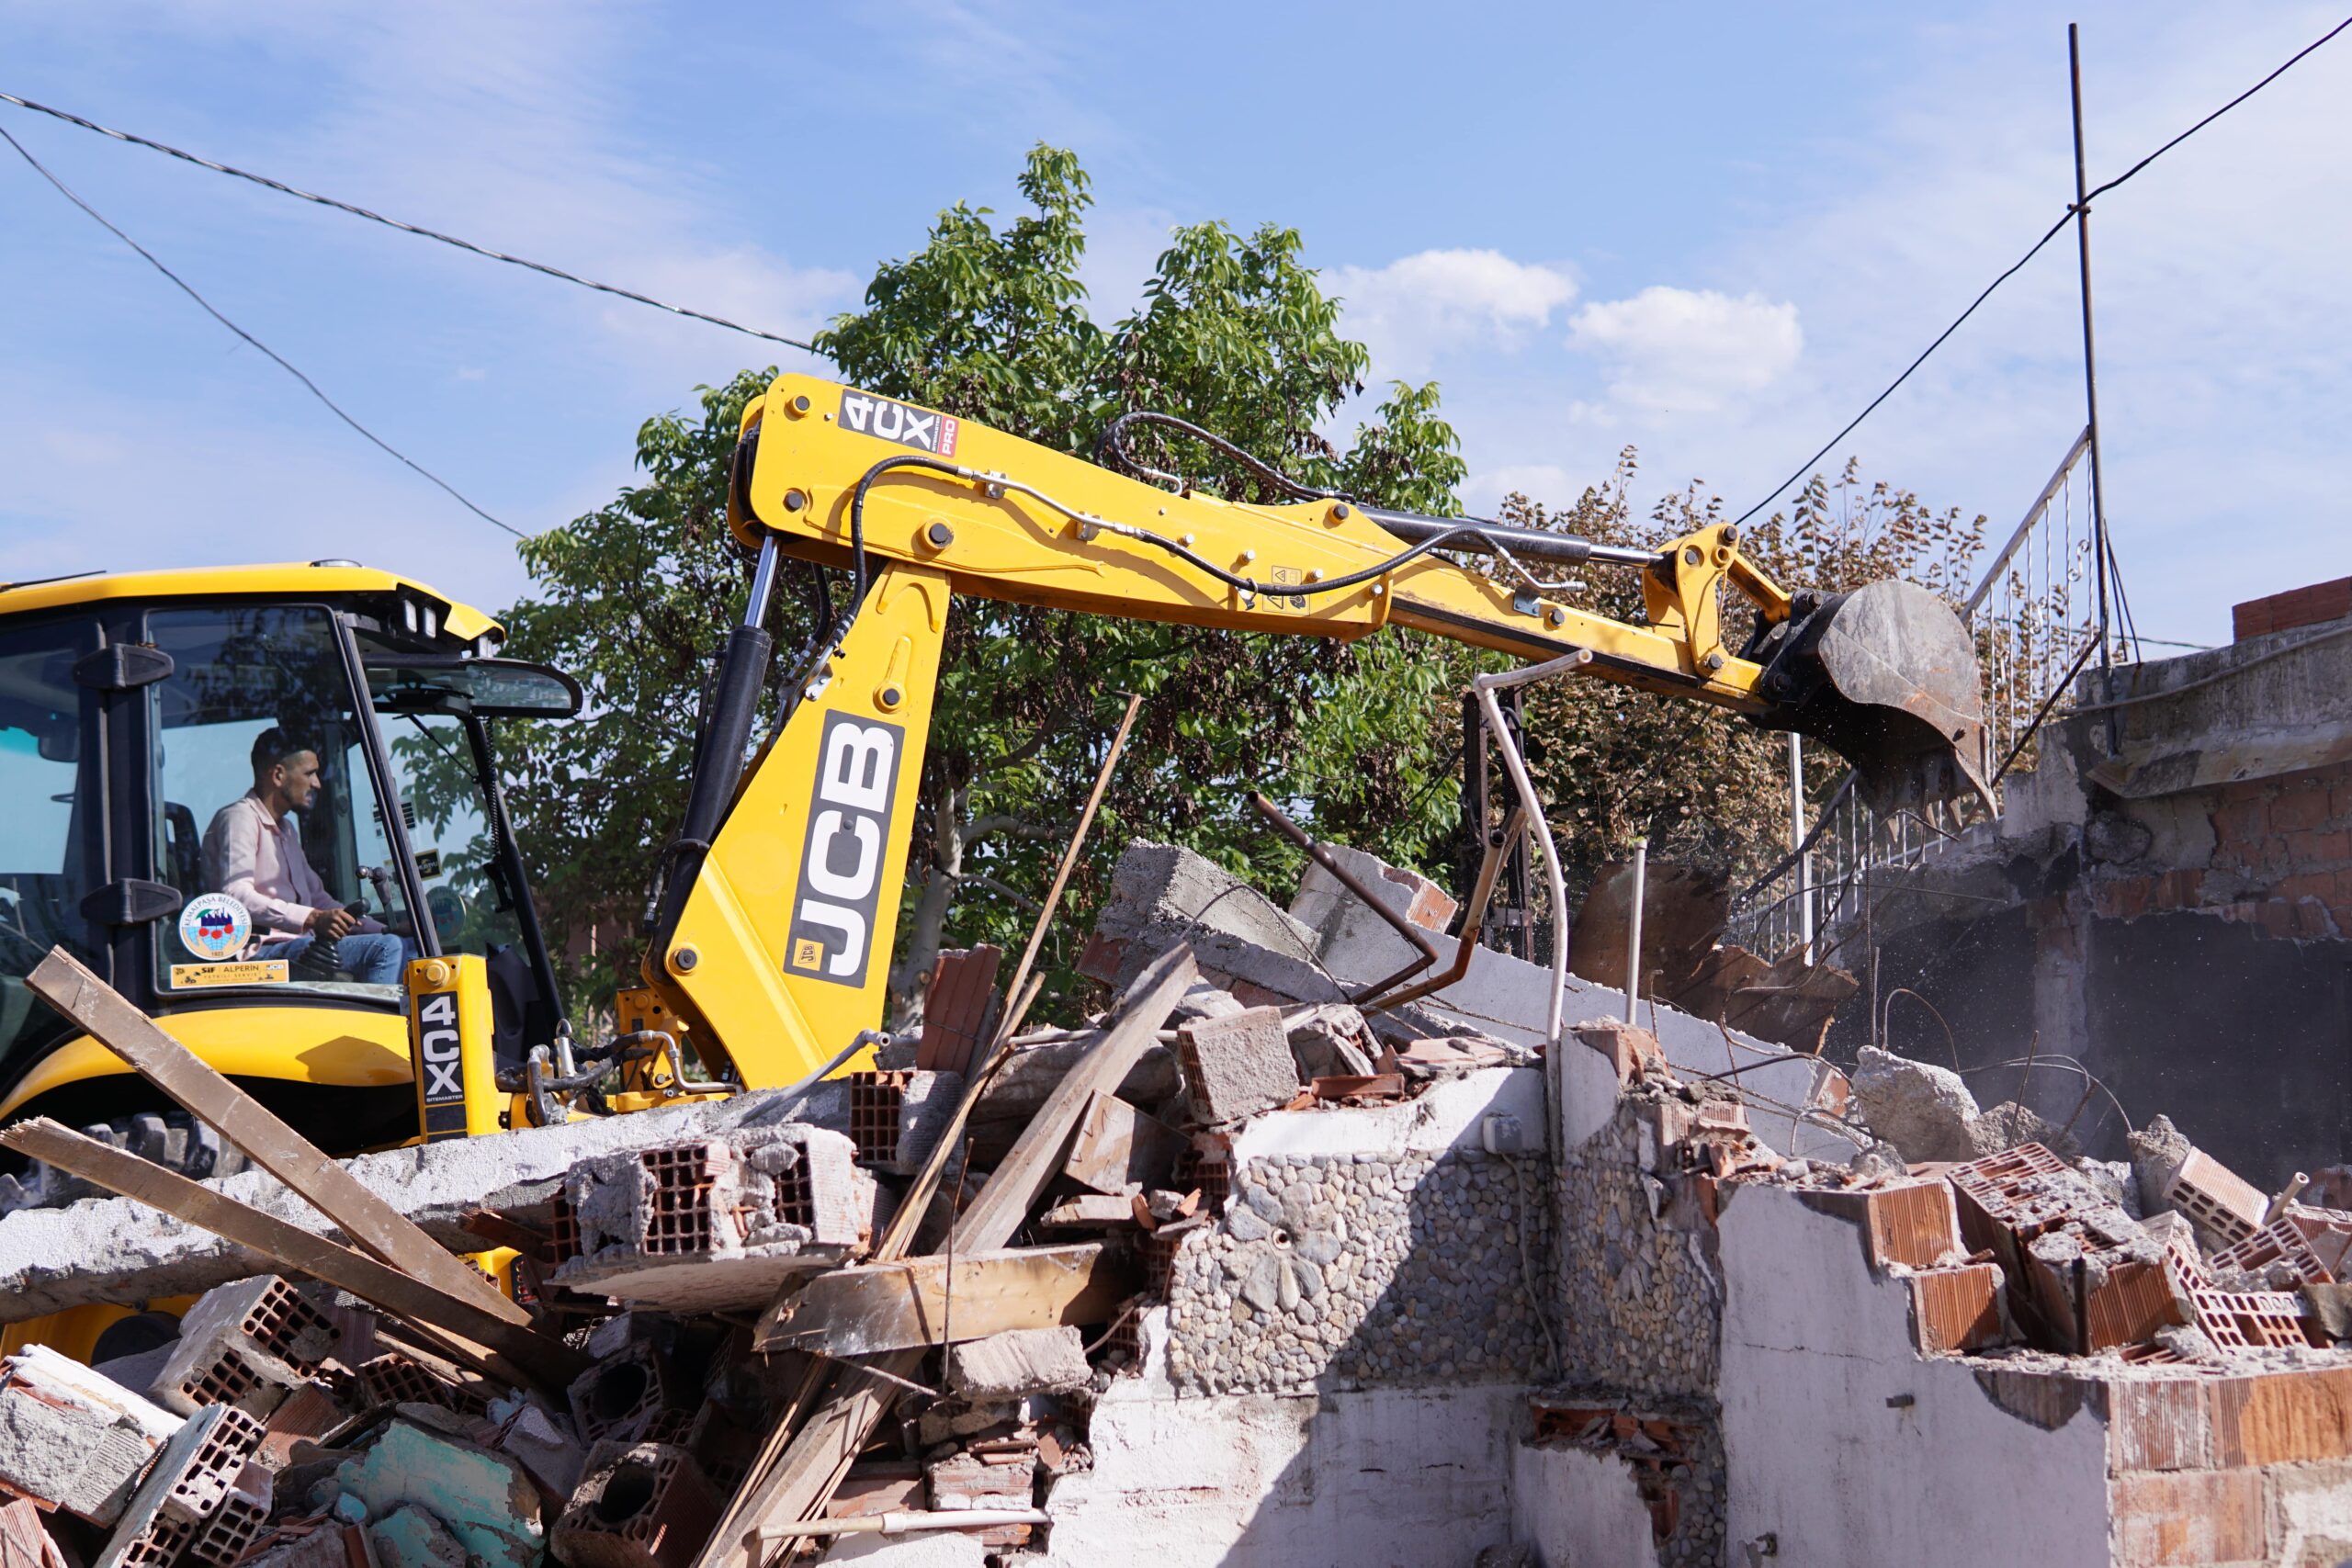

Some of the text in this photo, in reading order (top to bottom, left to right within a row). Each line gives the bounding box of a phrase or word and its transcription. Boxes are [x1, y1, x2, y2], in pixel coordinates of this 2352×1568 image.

[942, 419, 956, 456] PRO
[800, 722, 894, 976] JCB
[185, 896, 248, 926] KEMALPAŞA BELEDİYESİ
[223, 964, 259, 973] ALPERİN
[800, 945, 814, 962] JCB
[421, 995, 462, 1096] 4CX
[426, 1094, 464, 1103] SITEMASTER
